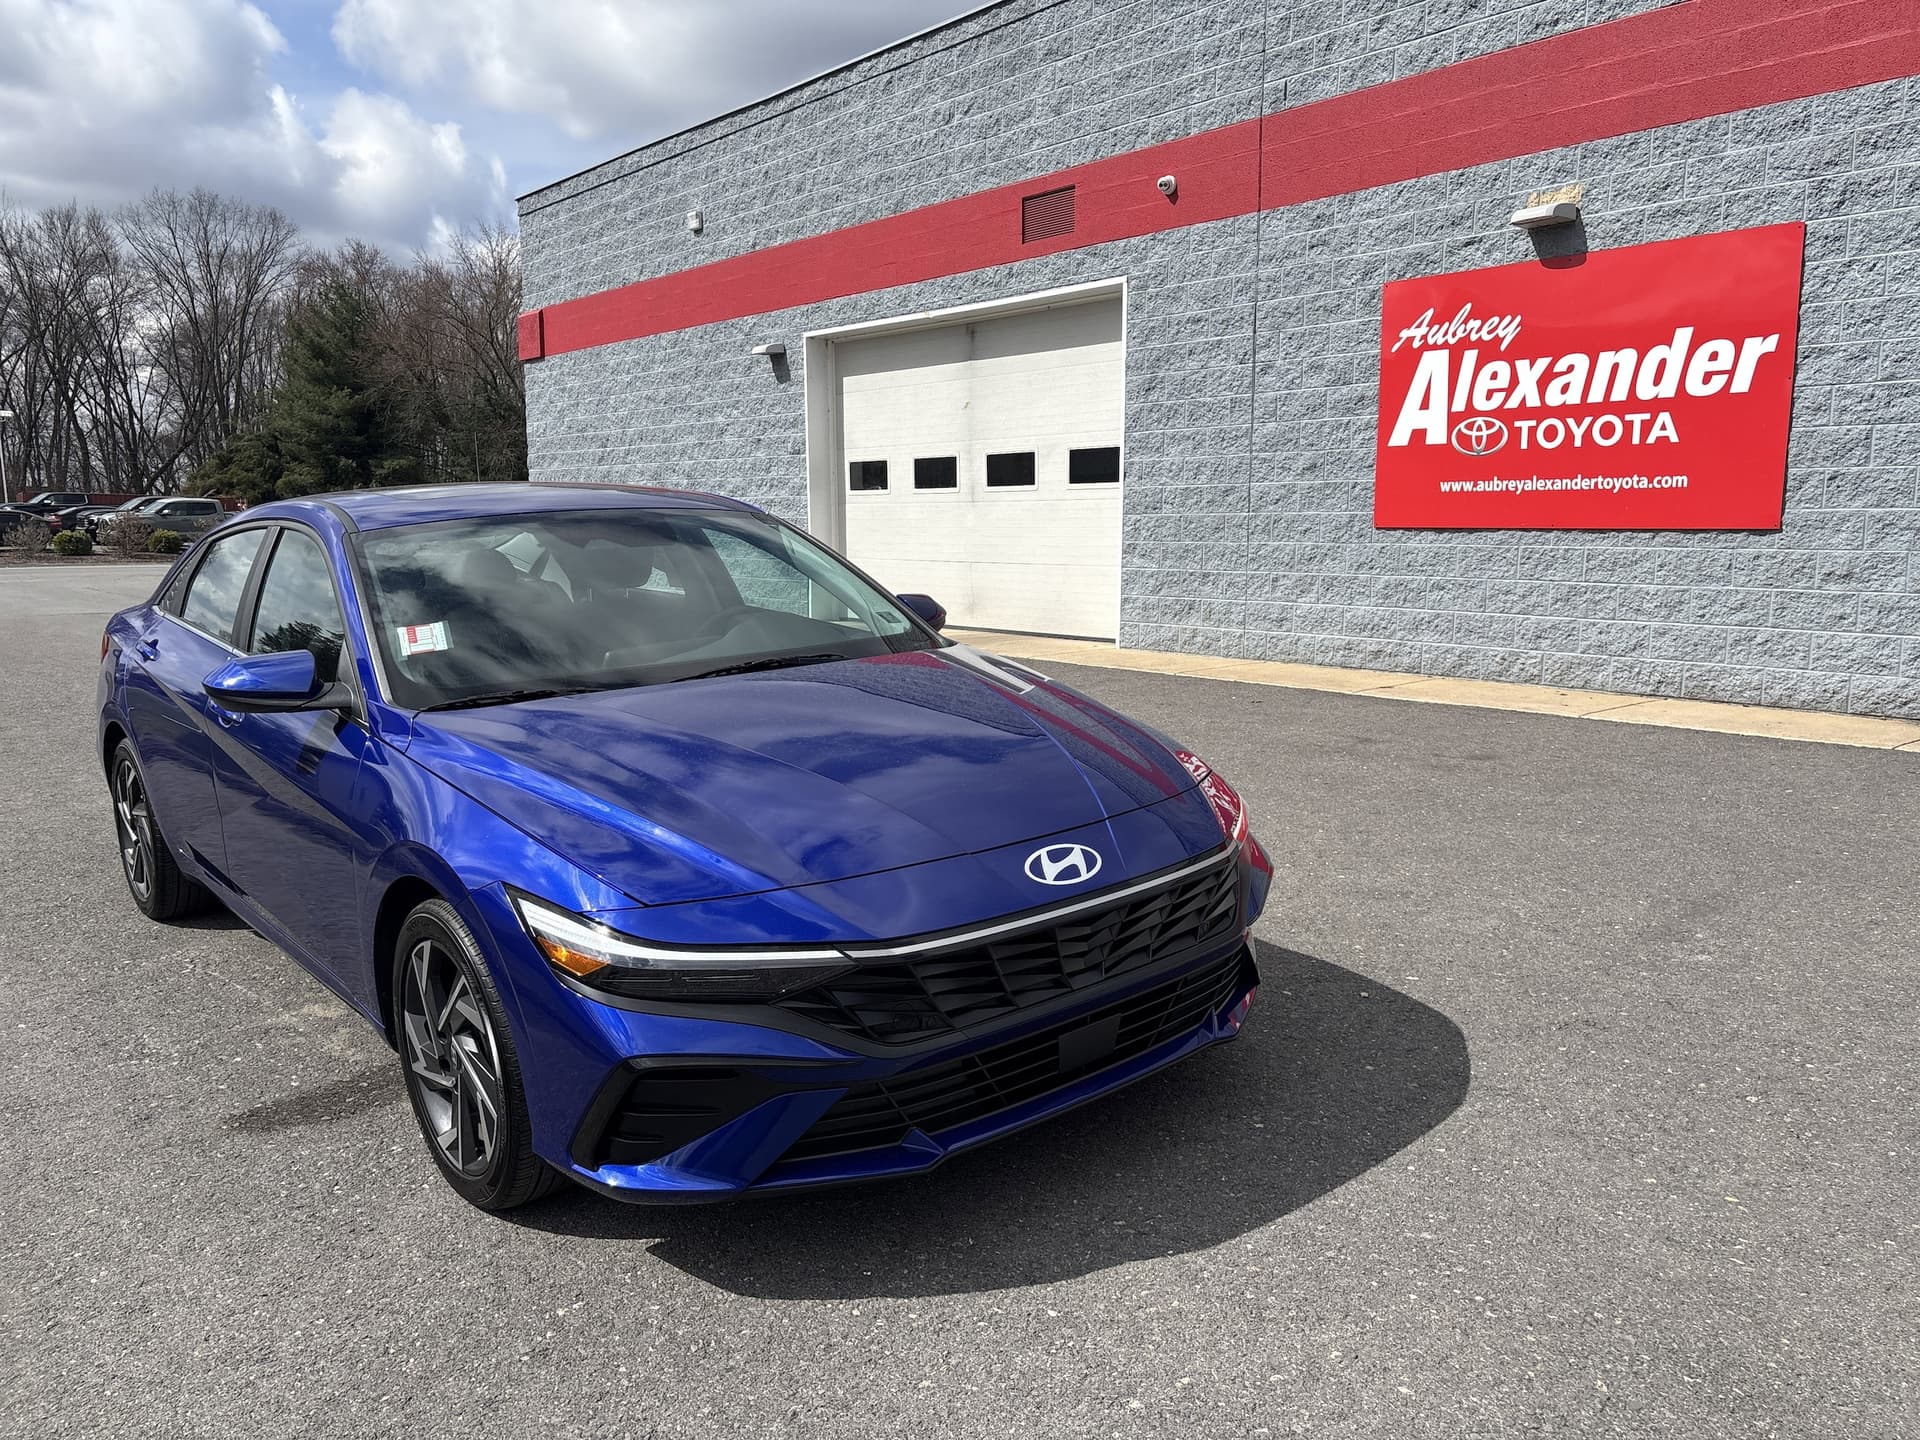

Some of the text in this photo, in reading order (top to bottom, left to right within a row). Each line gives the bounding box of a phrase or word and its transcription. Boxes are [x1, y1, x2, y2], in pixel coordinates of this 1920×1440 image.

[1391, 302, 1522, 353] Aubrey
[1387, 326, 1780, 447] Alexander
[1513, 411, 1680, 450] TOYOTA
[1439, 474, 1688, 495] www.aubreyalexandertoyota.com
